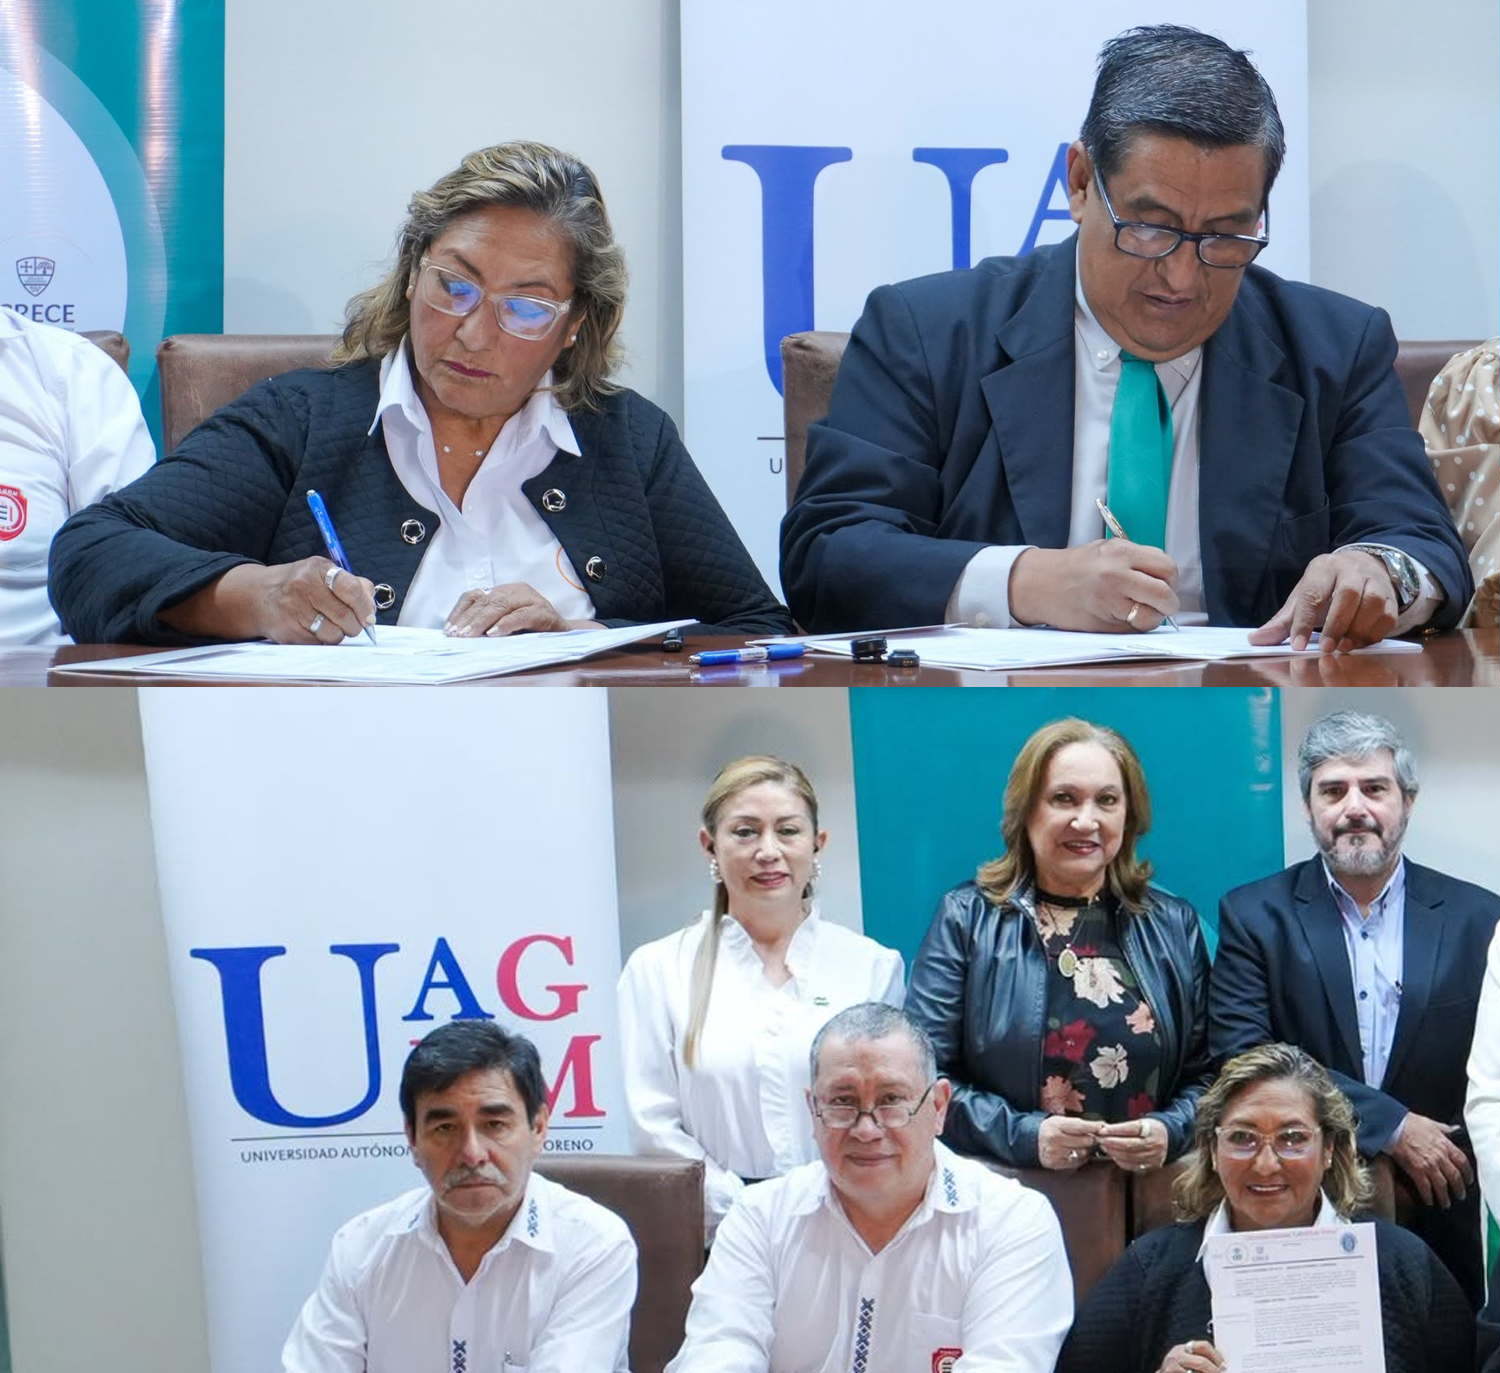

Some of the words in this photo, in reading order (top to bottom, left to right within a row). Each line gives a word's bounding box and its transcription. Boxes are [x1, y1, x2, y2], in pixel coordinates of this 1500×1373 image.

[240, 1148, 339, 1163] UNIVERSIDAD
[341, 1143, 412, 1158] AUTÓNO
[543, 1139, 594, 1151] ORENO
